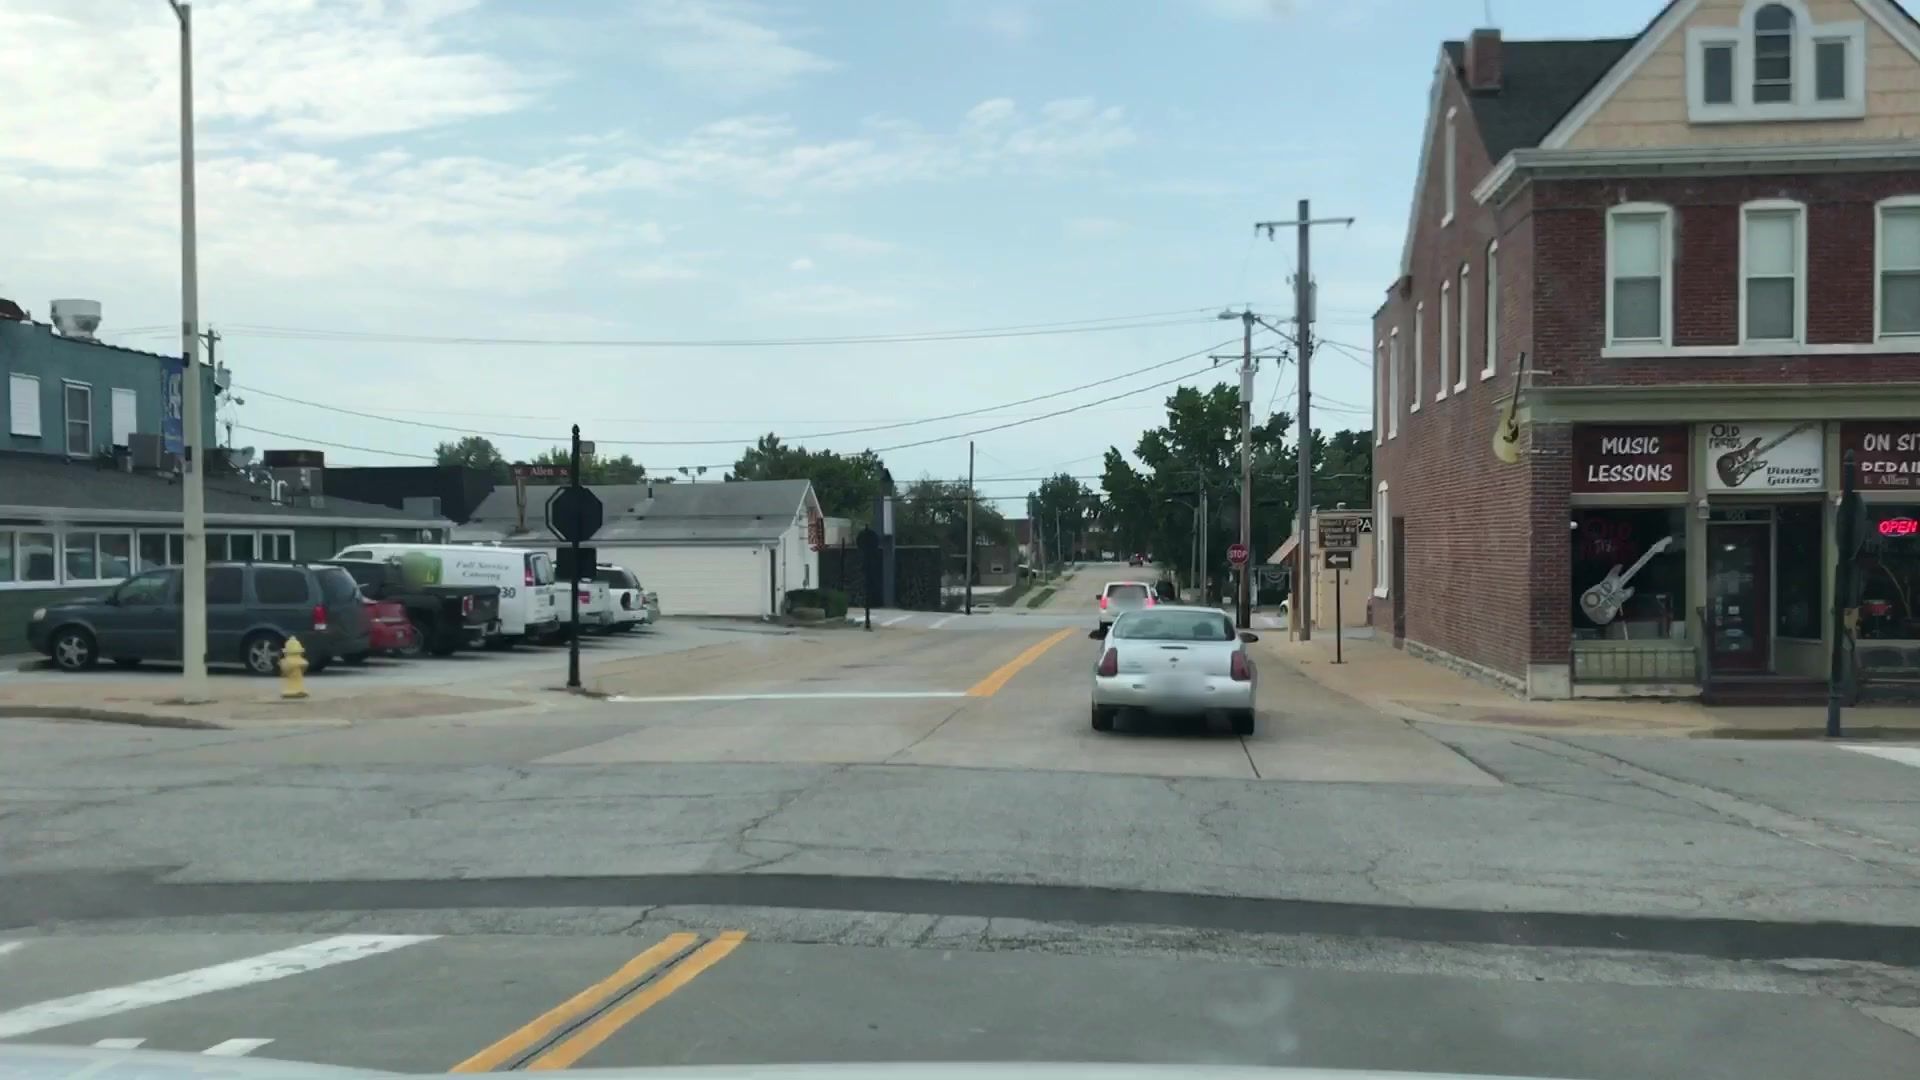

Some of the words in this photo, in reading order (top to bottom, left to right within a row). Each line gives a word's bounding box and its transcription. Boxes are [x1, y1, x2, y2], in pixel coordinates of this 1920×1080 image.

[1602, 437, 1660, 454] MUSIC
[1863, 433, 1890, 451] ON
[530, 466, 555, 476] Allen
[1588, 464, 1673, 482] LESSONS
[1767, 467, 1819, 477] Vintage
[1767, 476, 1820, 486] Guitars
[1879, 474, 1909, 485] Allen
[1879, 520, 1918, 533] OPEN
[1230, 550, 1248, 559] STOP
[456, 560, 476, 569] Full
[478, 561, 510, 571] Service
